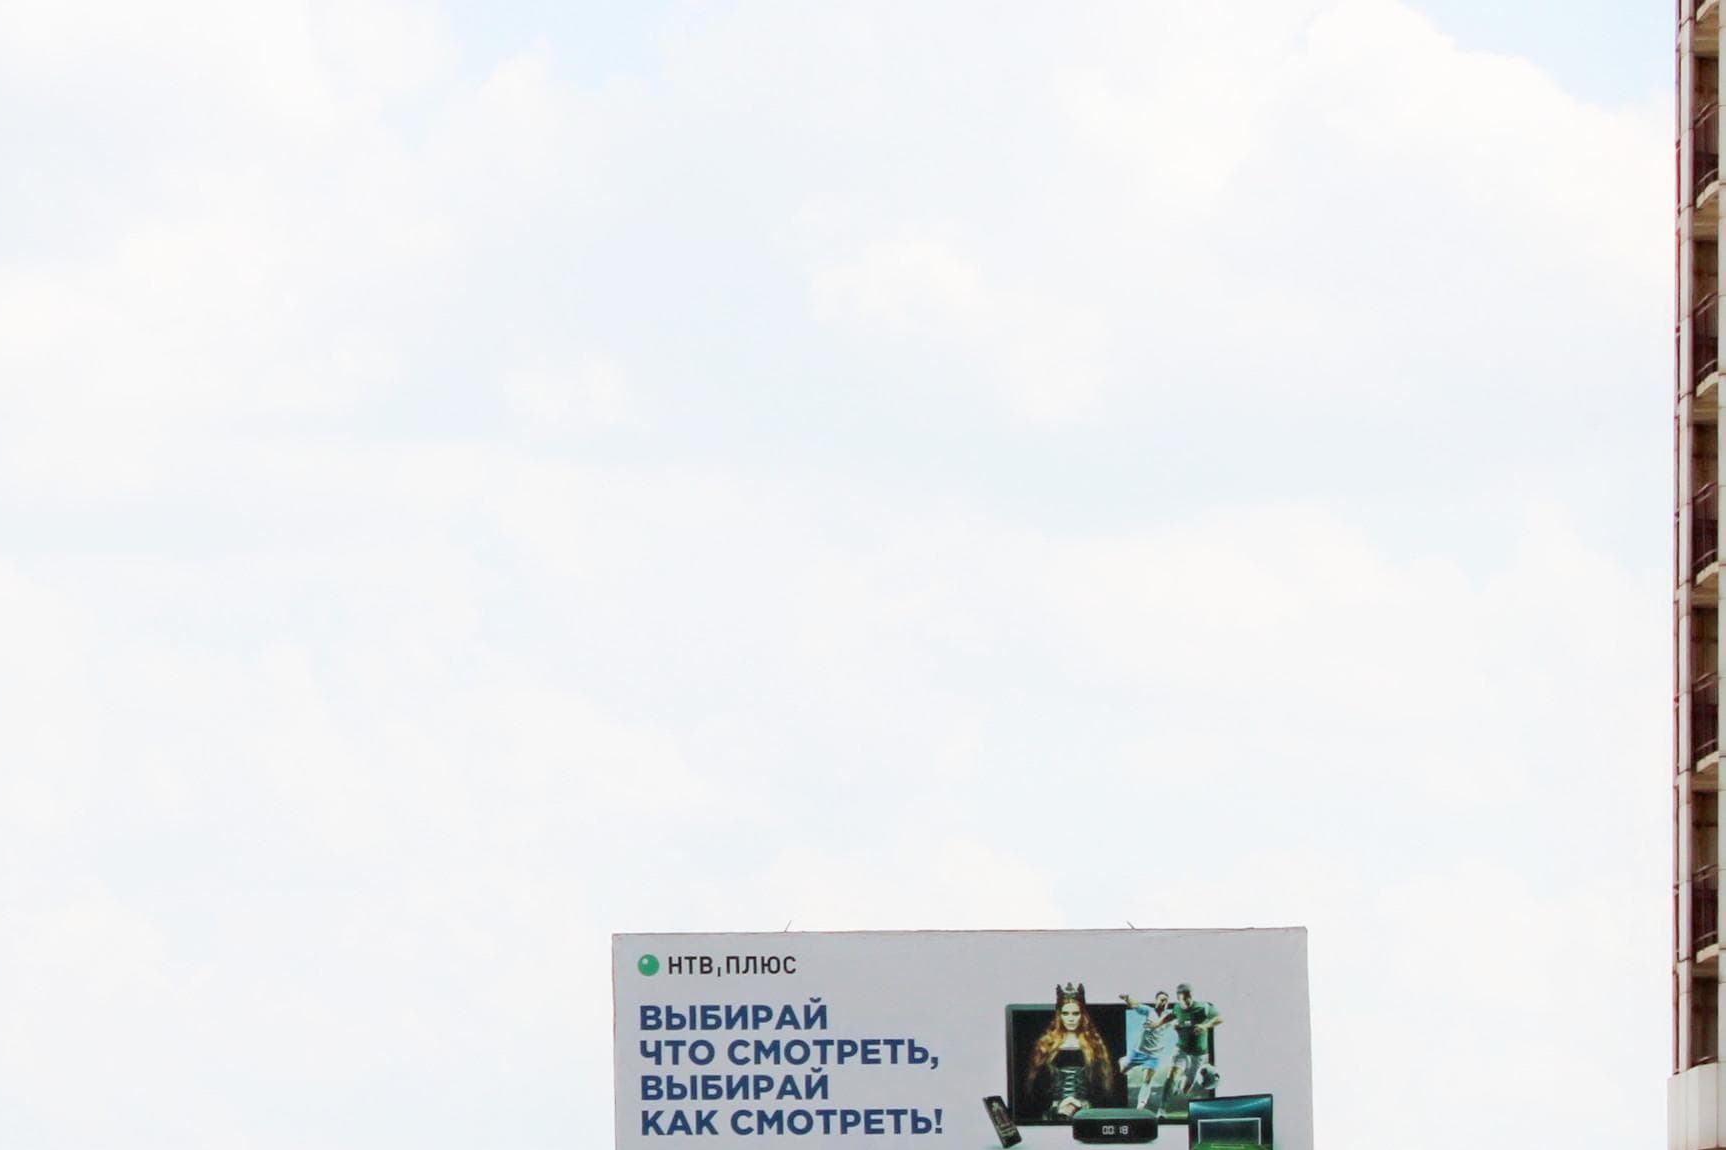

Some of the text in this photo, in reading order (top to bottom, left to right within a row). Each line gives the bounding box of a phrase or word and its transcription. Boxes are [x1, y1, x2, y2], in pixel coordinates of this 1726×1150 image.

[639, 997, 828, 1031] ВЫБИРАЙ
[639, 1038, 939, 1070] ЧТО СМОТРЕТЬ,
[640, 1066, 829, 1101] ВЫБИРАЙ
[641, 1108, 943, 1136] КАК СМОТРЕТЬ!
